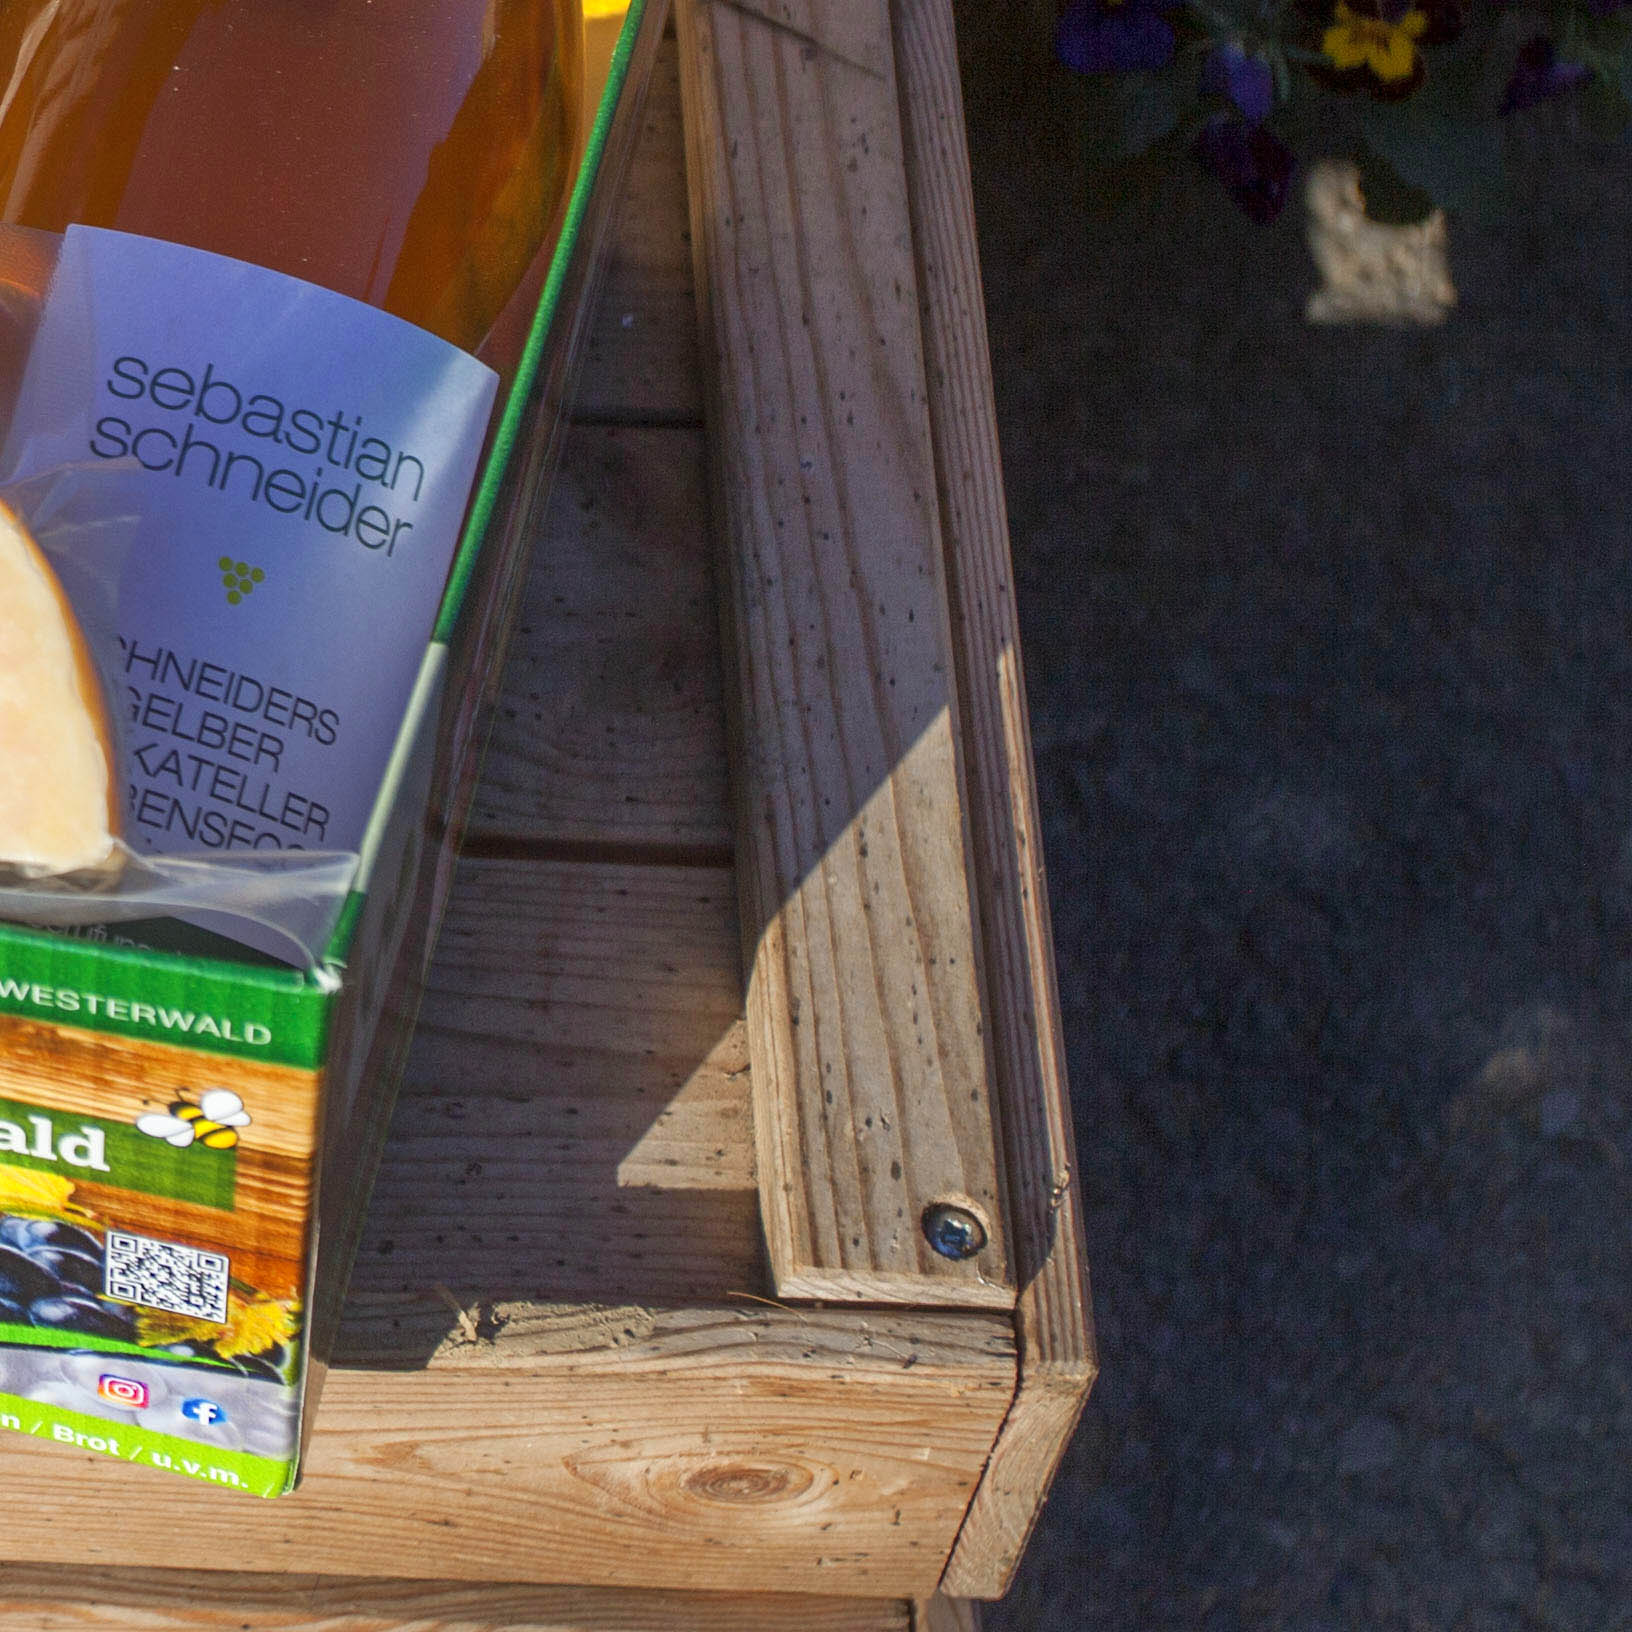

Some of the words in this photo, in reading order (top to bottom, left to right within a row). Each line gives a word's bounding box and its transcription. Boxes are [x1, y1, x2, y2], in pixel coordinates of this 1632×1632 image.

[88, 415, 414, 558] schneider
[106, 355, 425, 501] sebastian
[118, 633, 341, 746] HNEIDERS
[52, 1421, 123, 1459] Brot
[151, 1448, 250, 1490] u.v.m.
